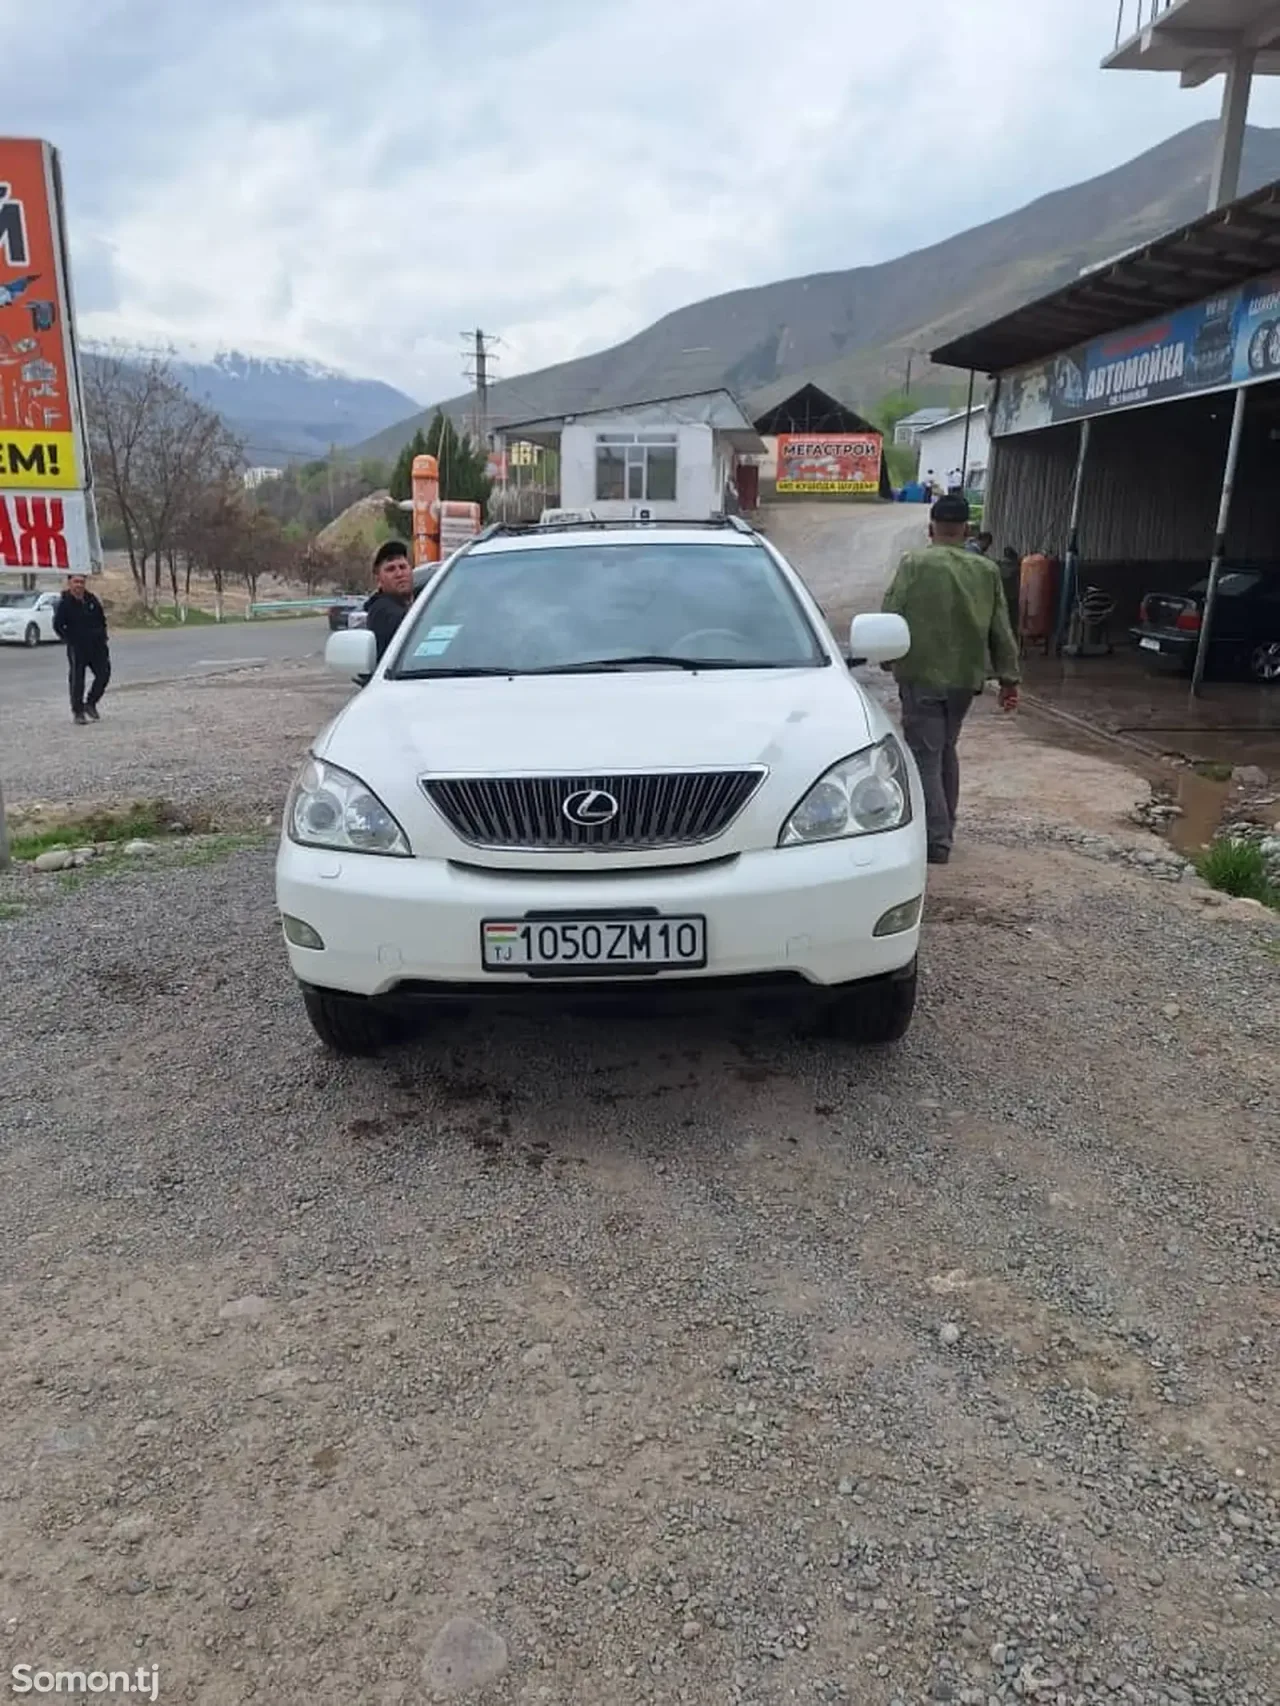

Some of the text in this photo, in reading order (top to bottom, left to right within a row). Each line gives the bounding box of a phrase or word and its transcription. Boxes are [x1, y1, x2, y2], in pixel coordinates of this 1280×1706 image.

[1085, 342, 1185, 401] АВТОМОЙКА
[0, 443, 60, 475] М!
[494, 946, 512, 961] TJ
